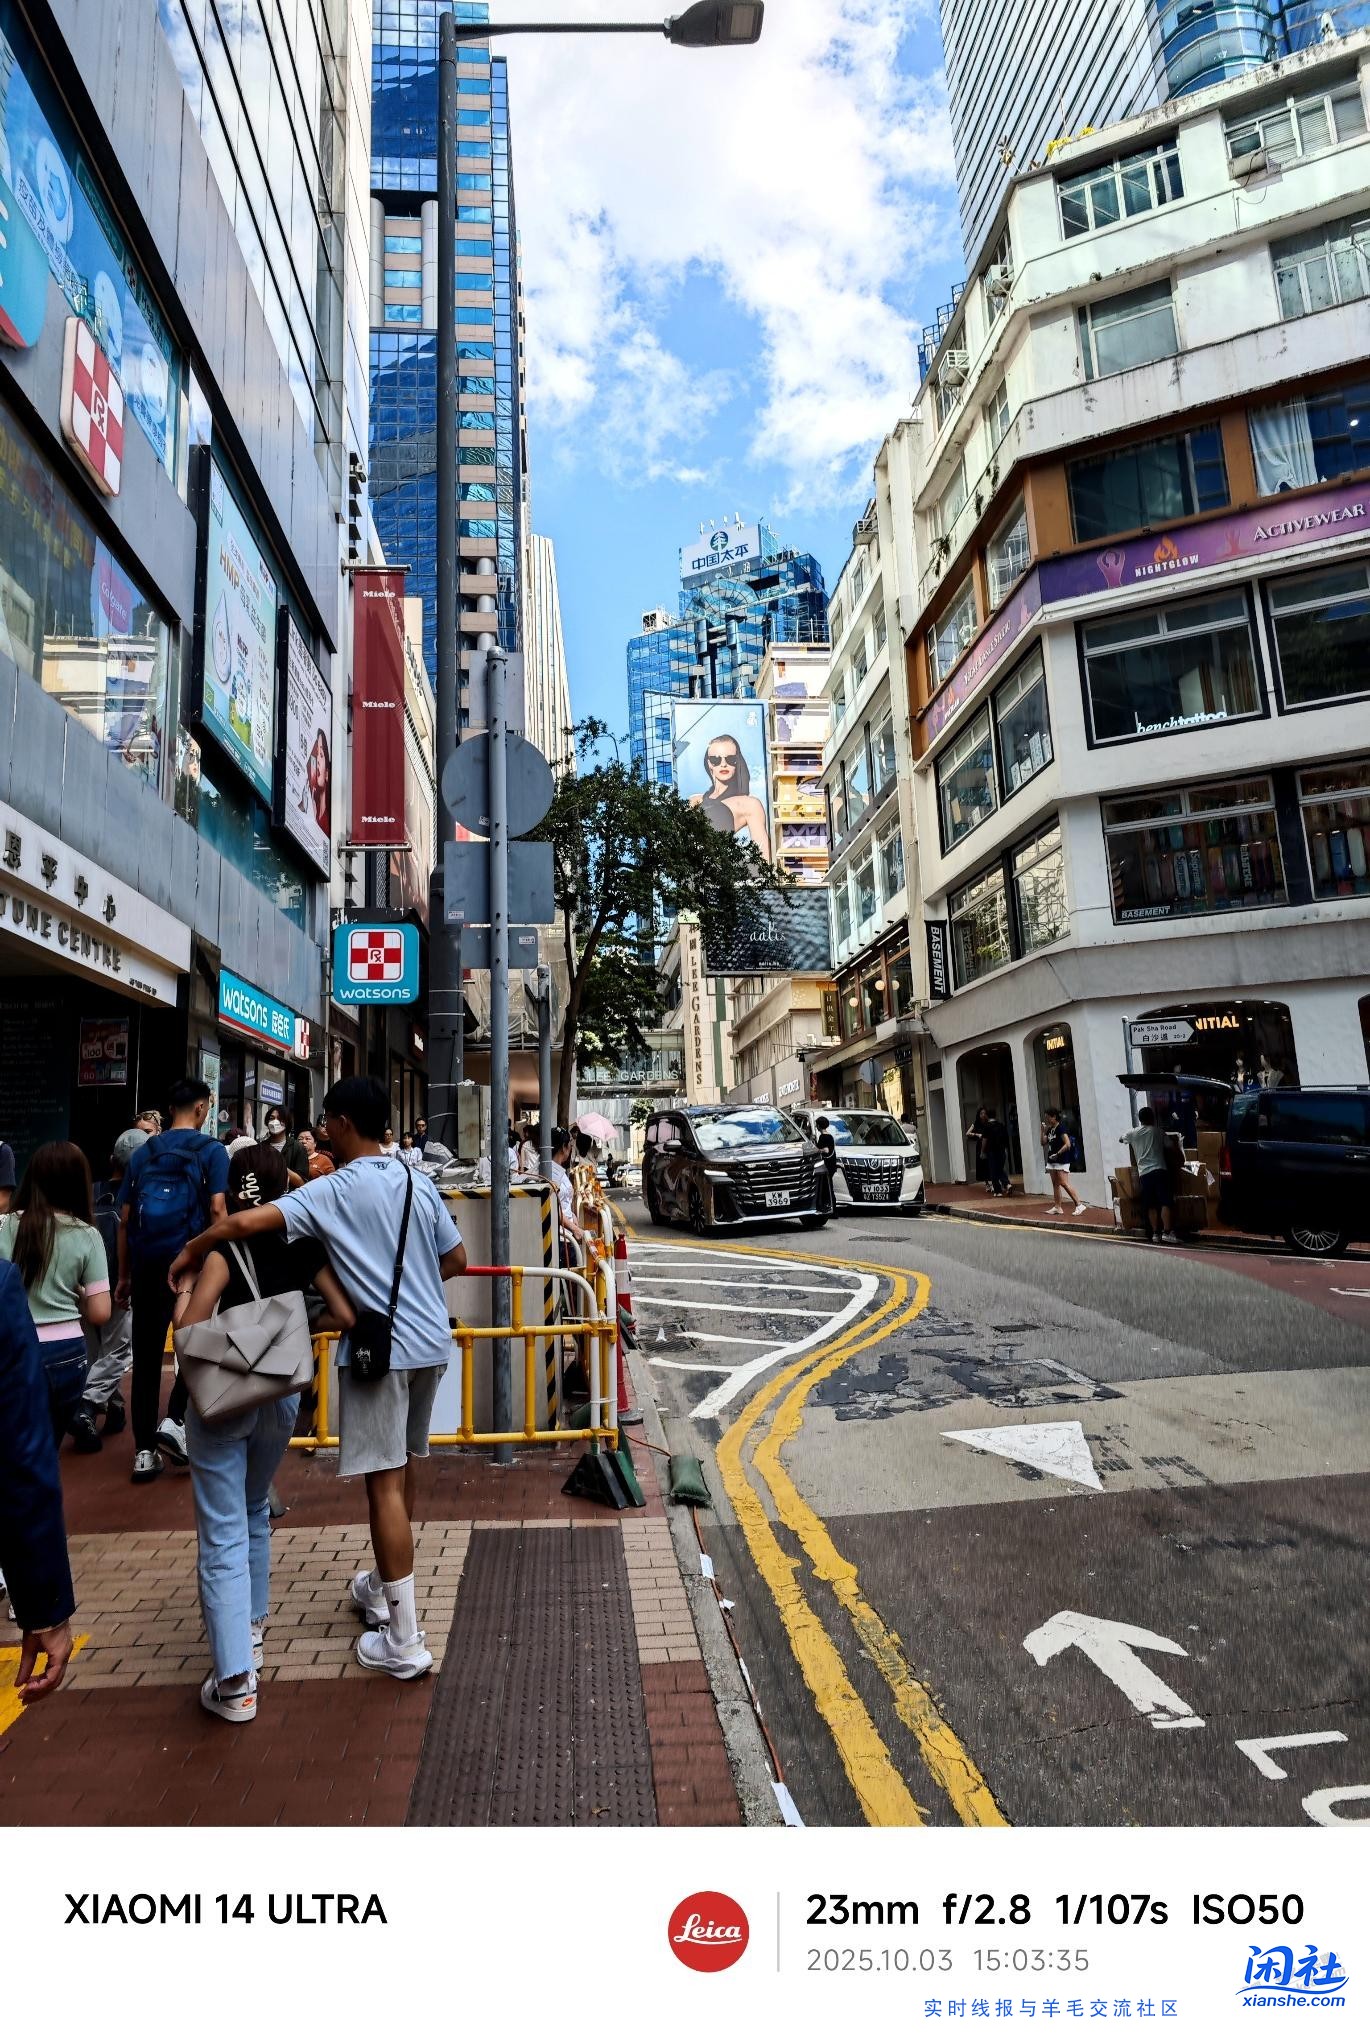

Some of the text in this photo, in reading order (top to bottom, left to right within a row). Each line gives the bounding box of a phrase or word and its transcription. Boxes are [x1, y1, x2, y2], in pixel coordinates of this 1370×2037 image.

[1253, 503, 1366, 542] ACTIVEWEAR
[691, 543, 749, 570] 中国太平
[1134, 554, 1200, 578] NIGHTGLOW
[101, 581, 128, 620] Colgate
[362, 590, 396, 598] Miele
[362, 701, 396, 709] Miele
[362, 815, 396, 823] Miele
[1122, 905, 1171, 919] BASEMENT
[57, 921, 122, 973] CENTRE
[930, 925, 945, 994] BASEMENT
[339, 987, 411, 999] watsons
[222, 982, 269, 1029] watsons
[691, 956, 703, 1085] LEE GARDENS
[1195, 1015, 1240, 1031] NITIAL
[1142, 1033, 1169, 1042] 白沙道
[588, 1069, 679, 1083] LEE GARDENS
[767, 1198, 789, 1207] 3969
[771, 1191, 783, 1199] KW
